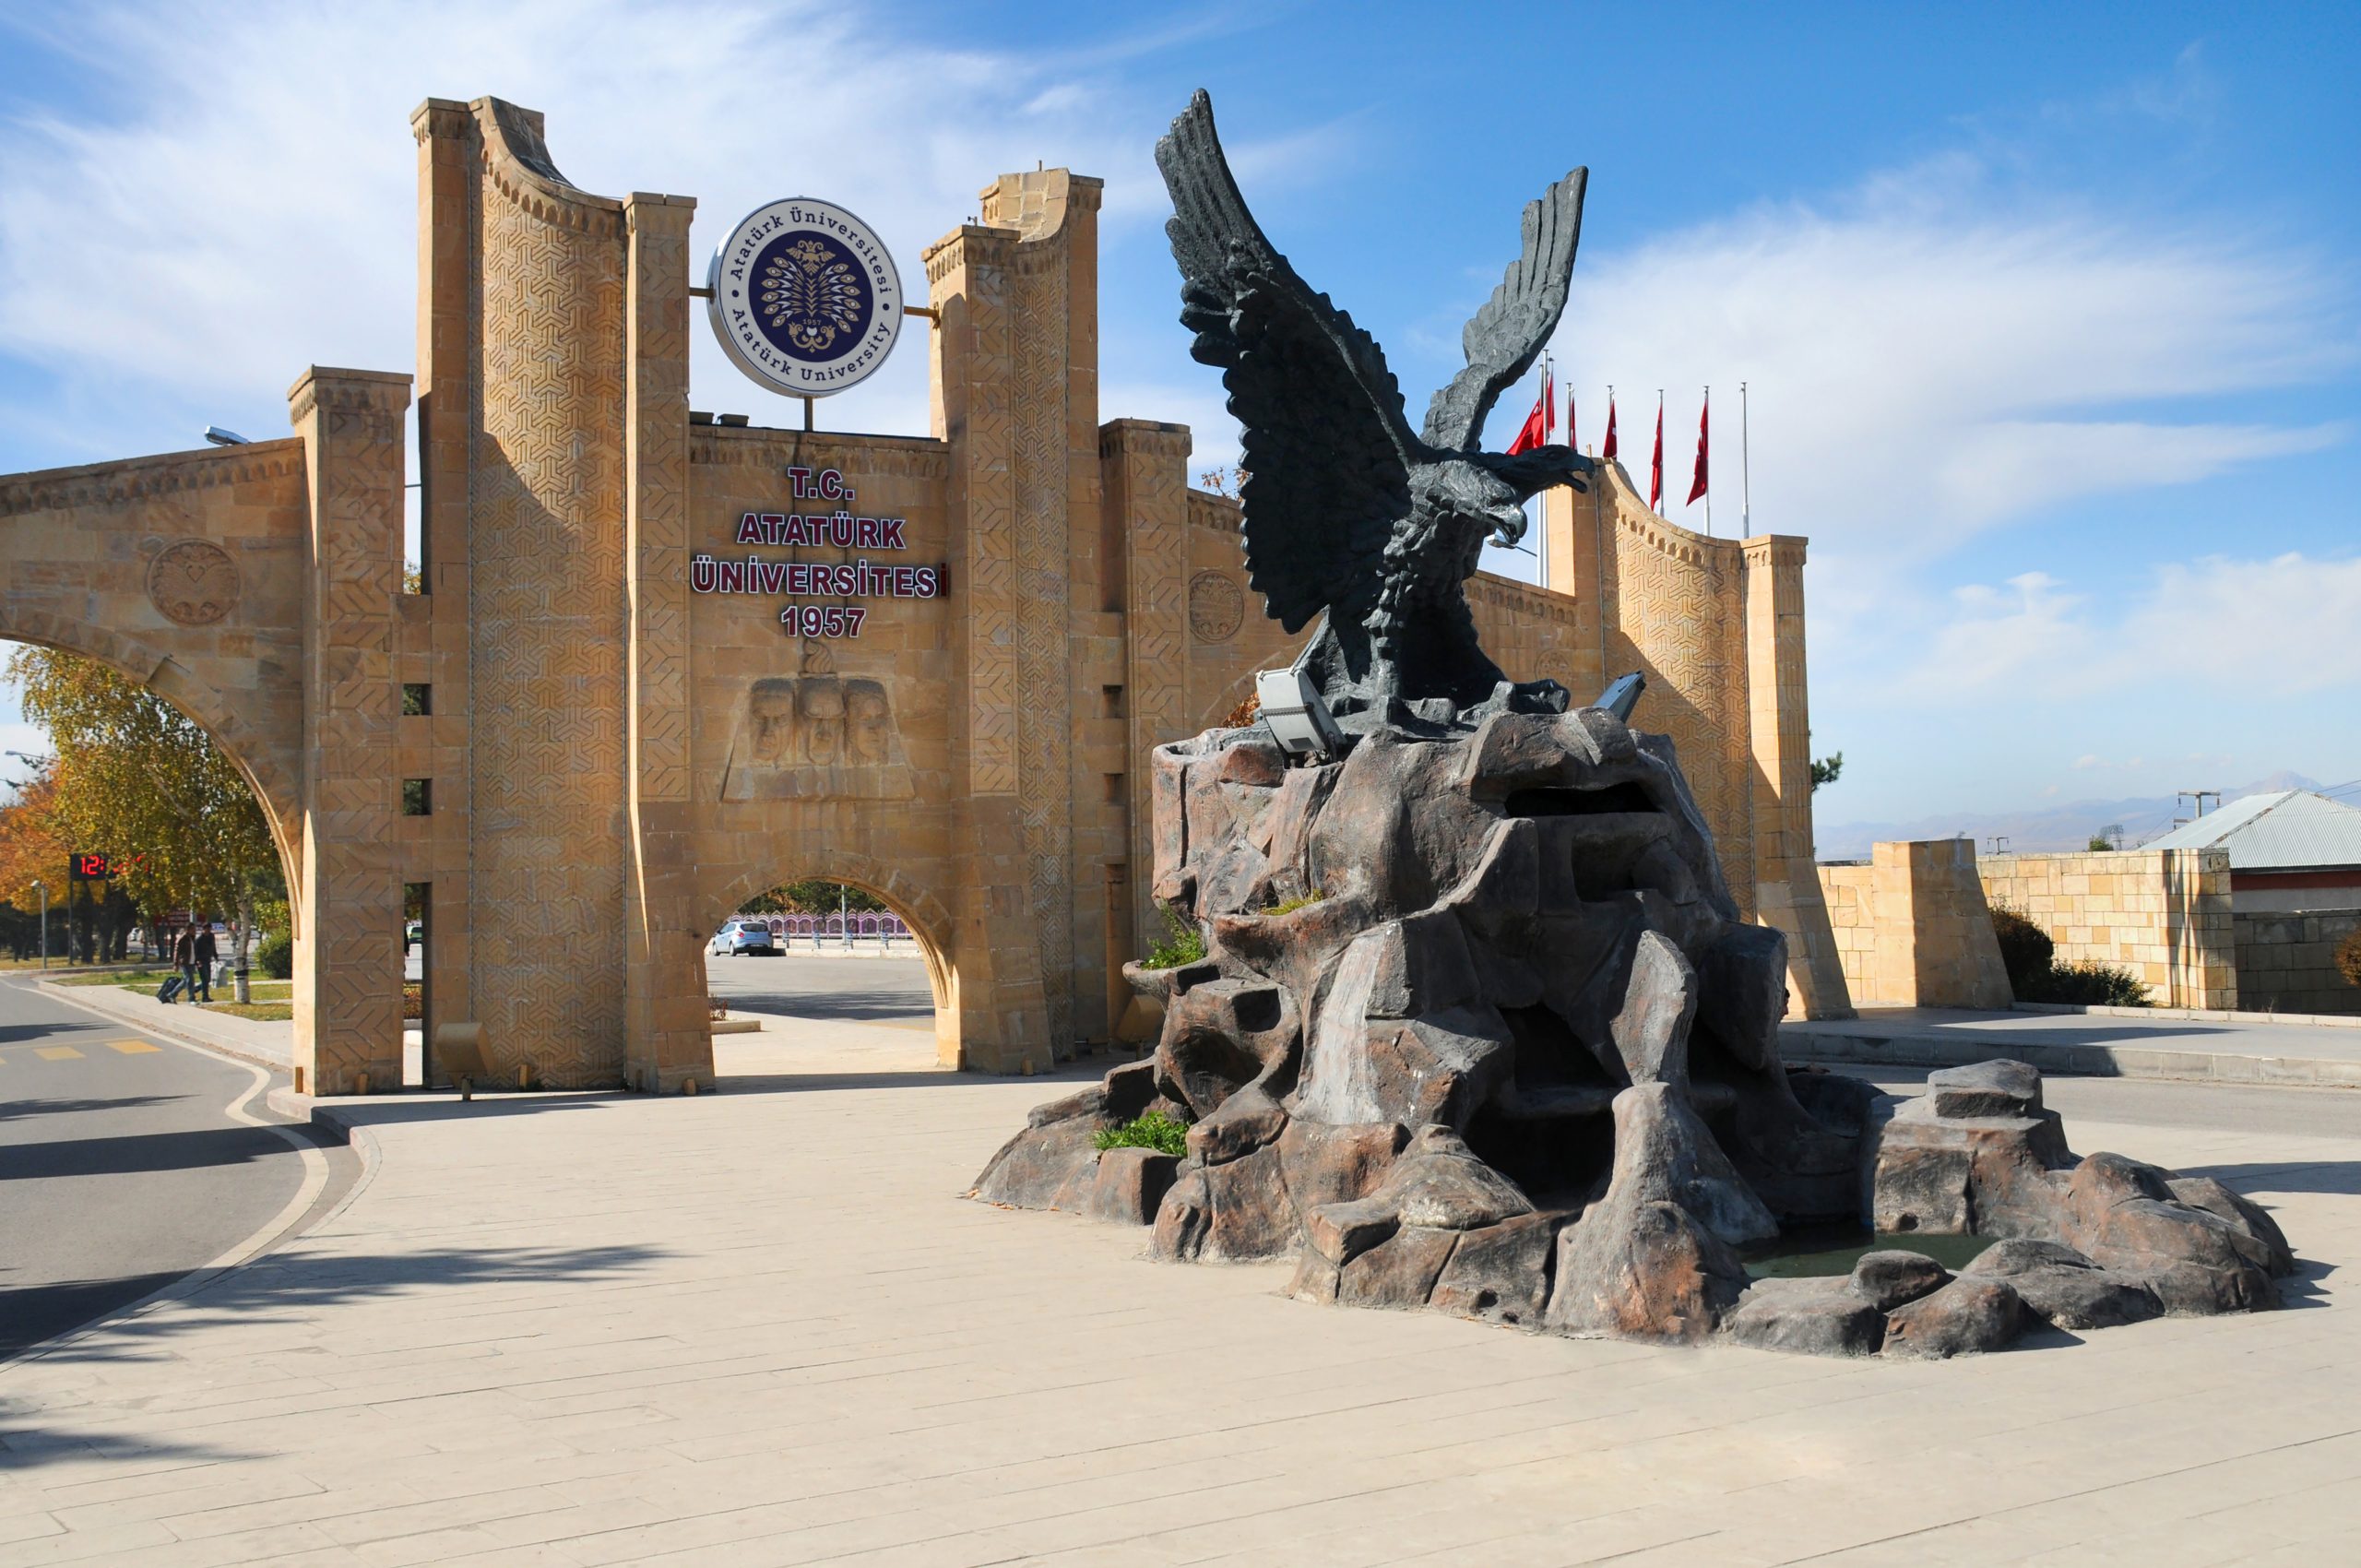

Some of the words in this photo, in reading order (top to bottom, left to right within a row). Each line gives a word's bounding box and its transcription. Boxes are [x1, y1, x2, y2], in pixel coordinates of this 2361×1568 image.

[730, 215, 784, 281] Atatürk
[790, 207, 892, 294] Üniversitesi
[733, 309, 792, 375] Atatürk
[801, 322, 891, 381] University
[788, 467, 855, 501] T.C.
[737, 511, 907, 549] ATATÜRK
[691, 555, 949, 599] ÜNİVERSİTESİ
[781, 606, 866, 638] 1957
